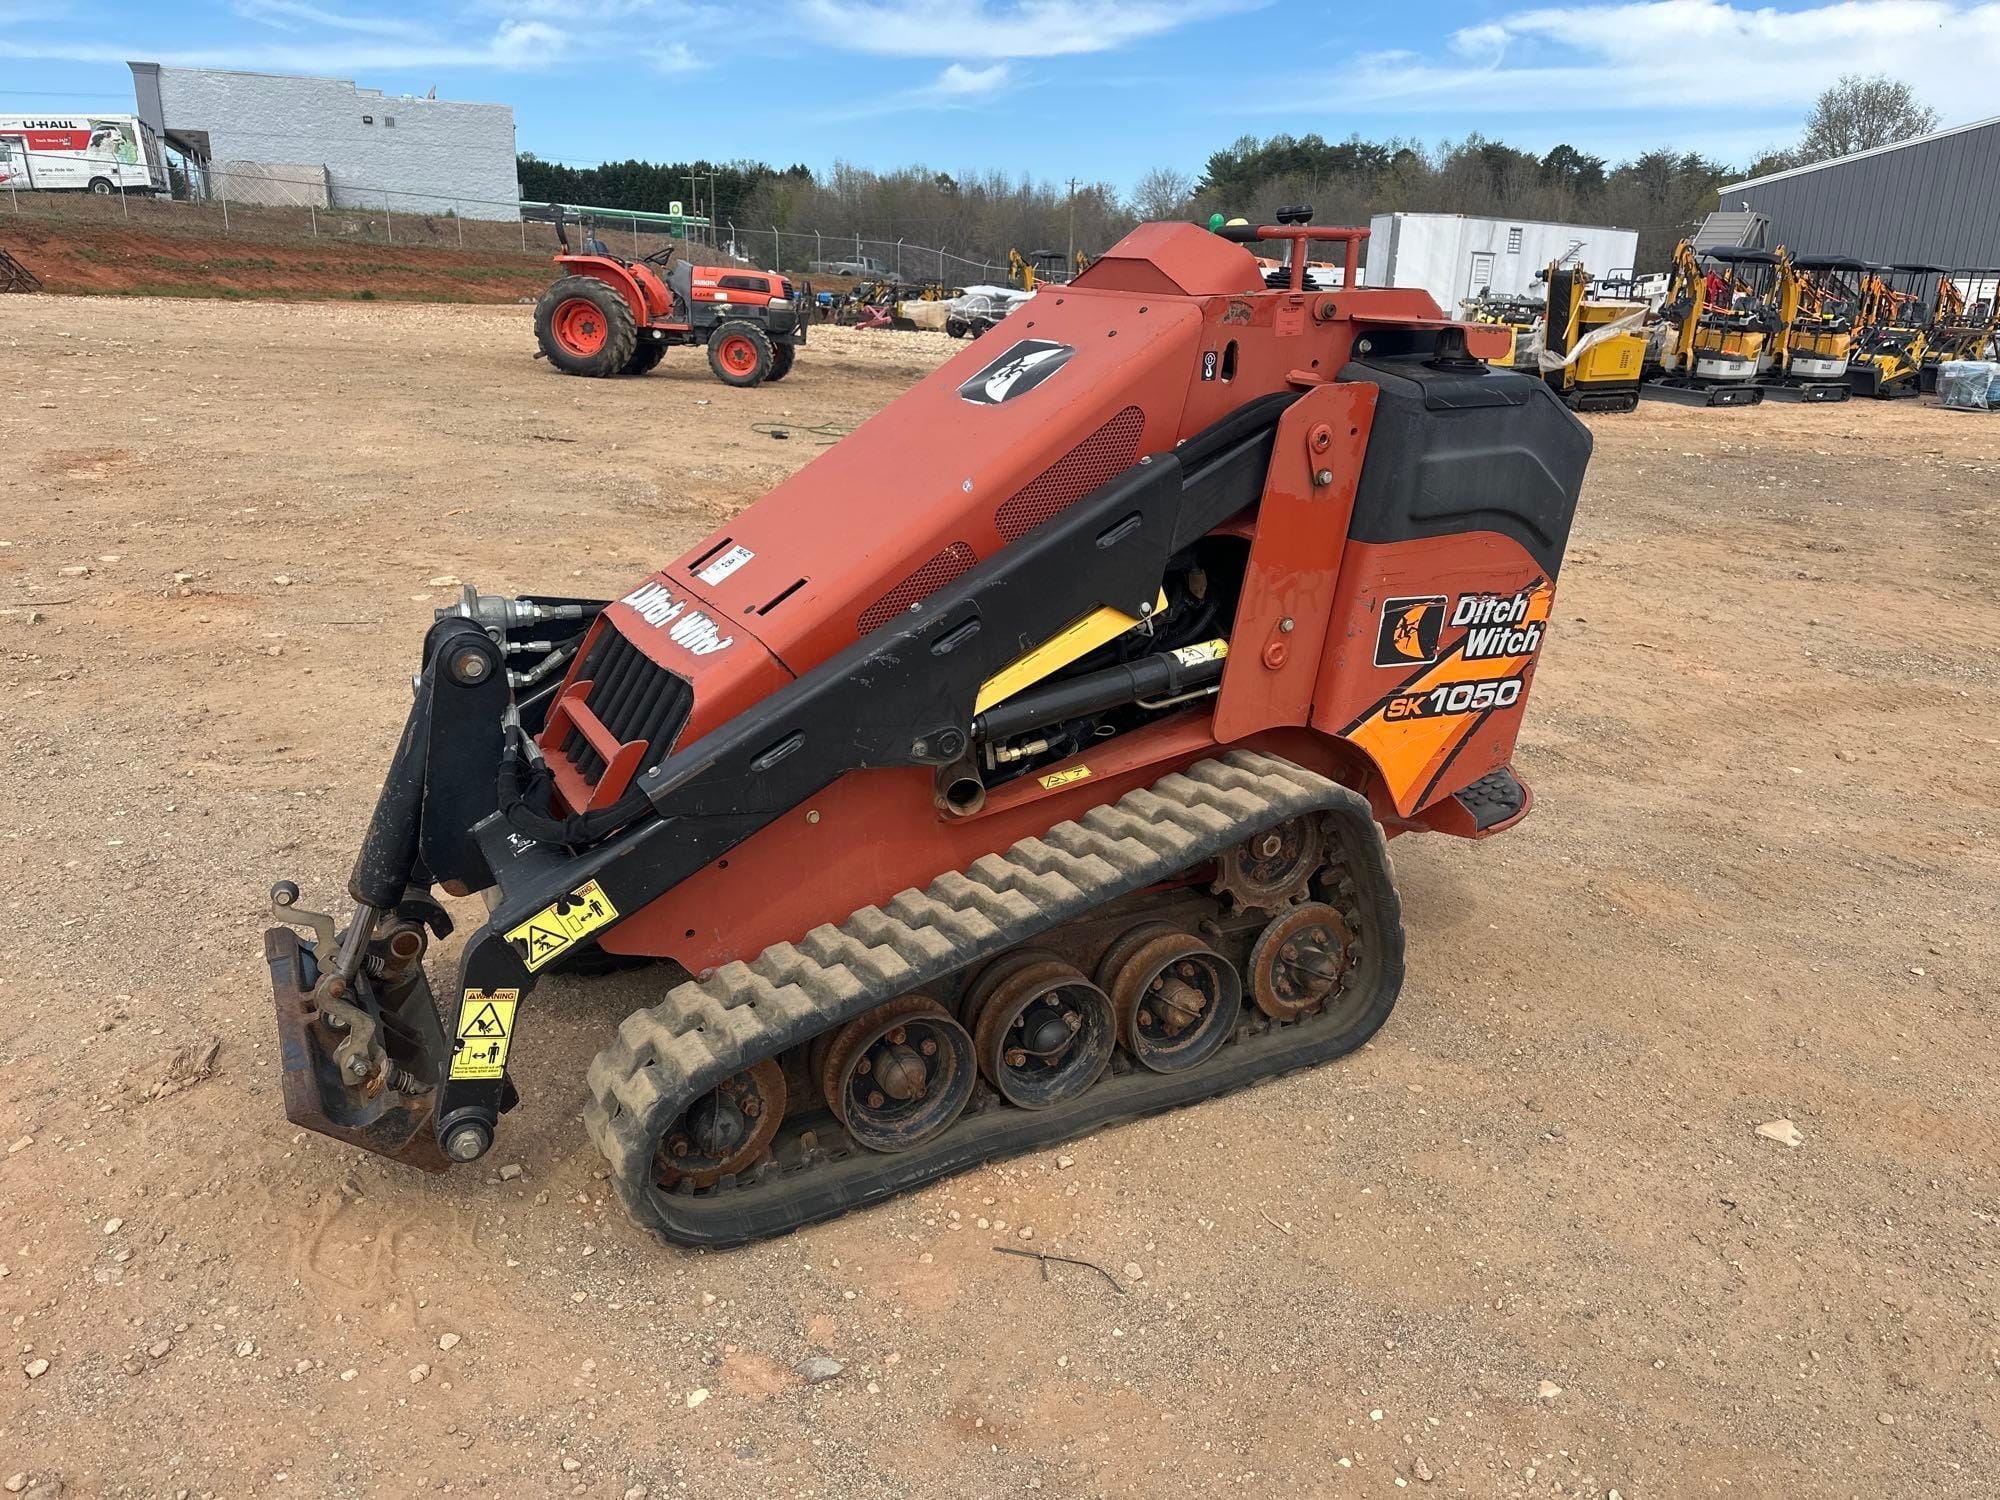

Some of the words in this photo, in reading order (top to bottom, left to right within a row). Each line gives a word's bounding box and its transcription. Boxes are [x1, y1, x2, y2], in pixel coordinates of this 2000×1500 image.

[1451, 593, 1528, 626] Ditch
[1465, 625, 1542, 657] Witch
[1387, 696, 1427, 718] SK
[1430, 679, 1522, 712] 1050
